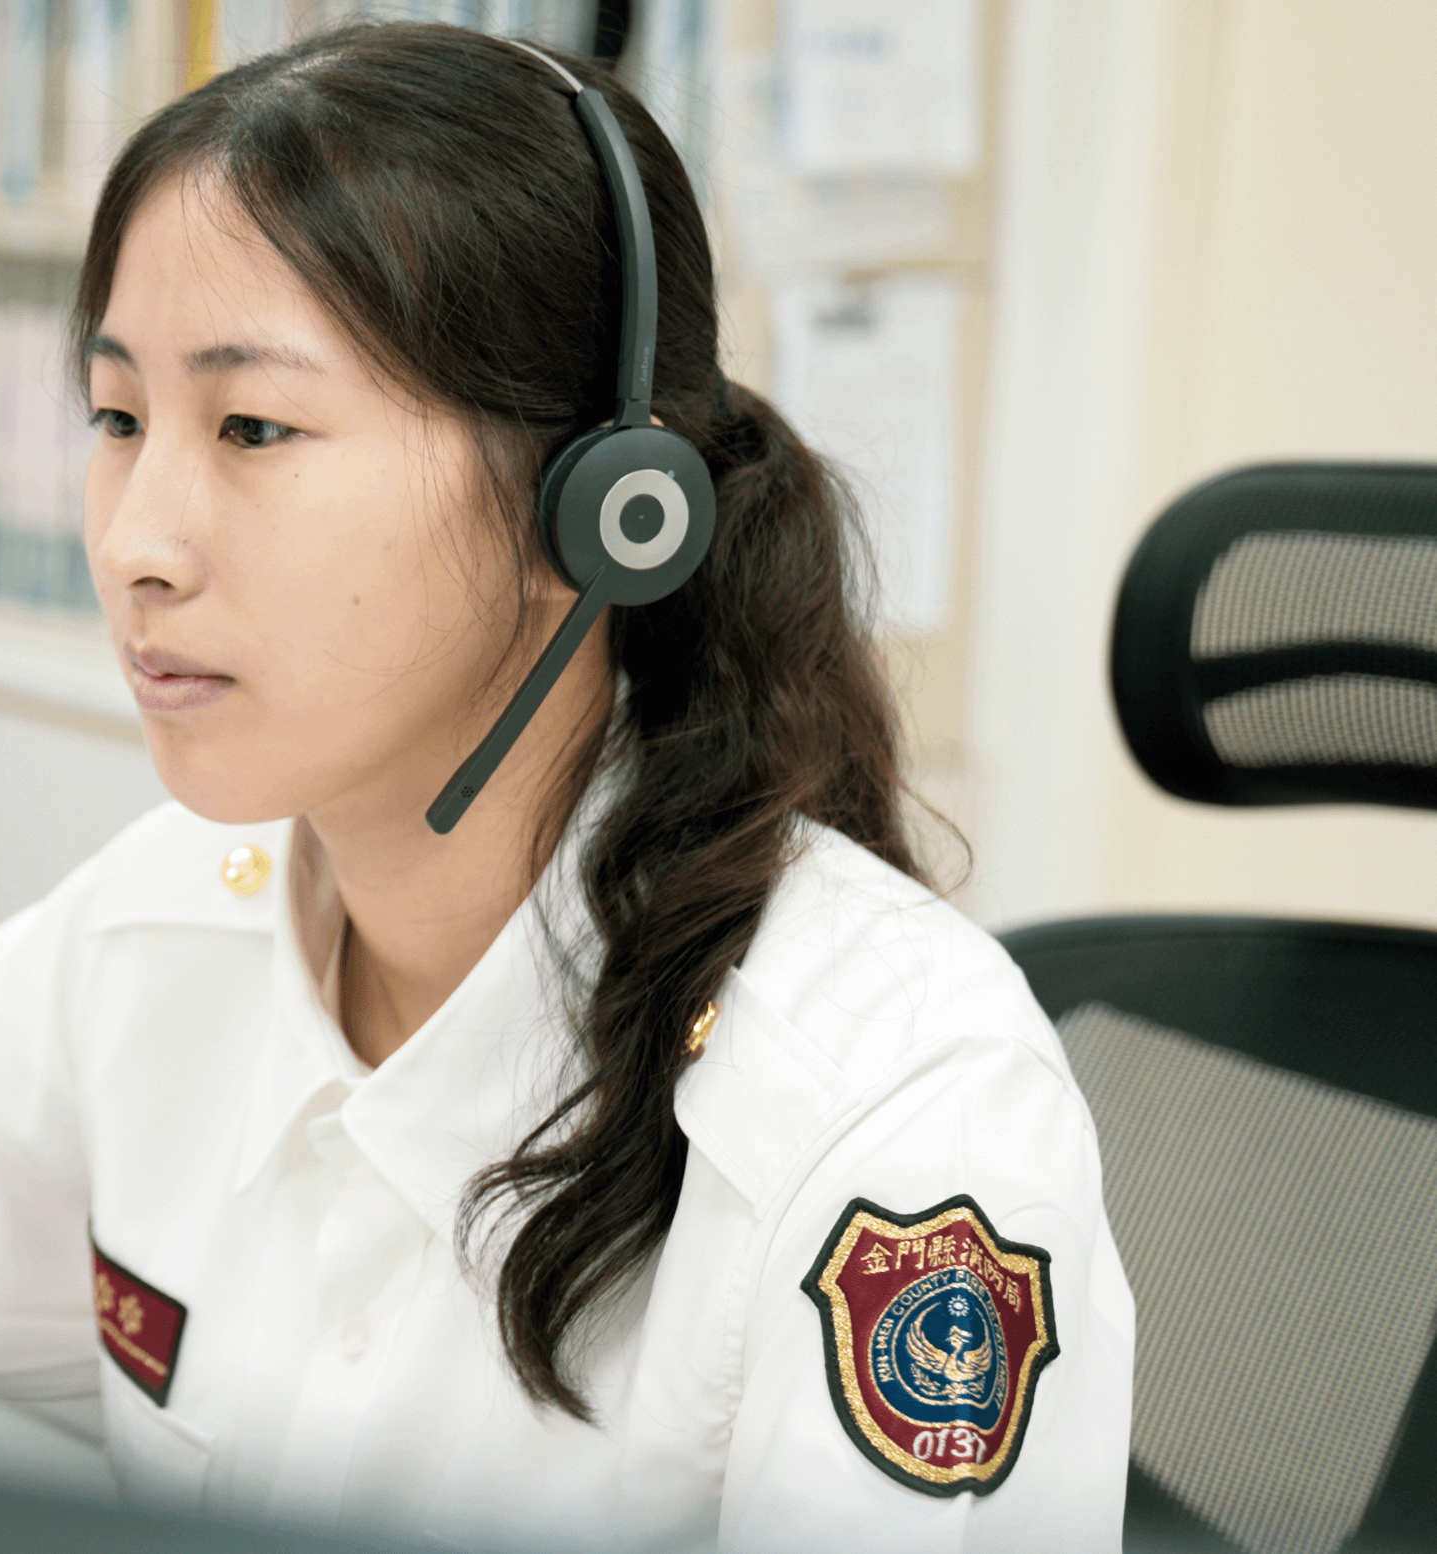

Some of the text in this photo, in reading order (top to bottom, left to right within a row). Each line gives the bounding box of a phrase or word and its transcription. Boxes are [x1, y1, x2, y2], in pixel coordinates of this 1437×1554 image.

[860, 1234, 1022, 1313] 金門縣消防局
[891, 1272, 952, 1316] COUNTY
